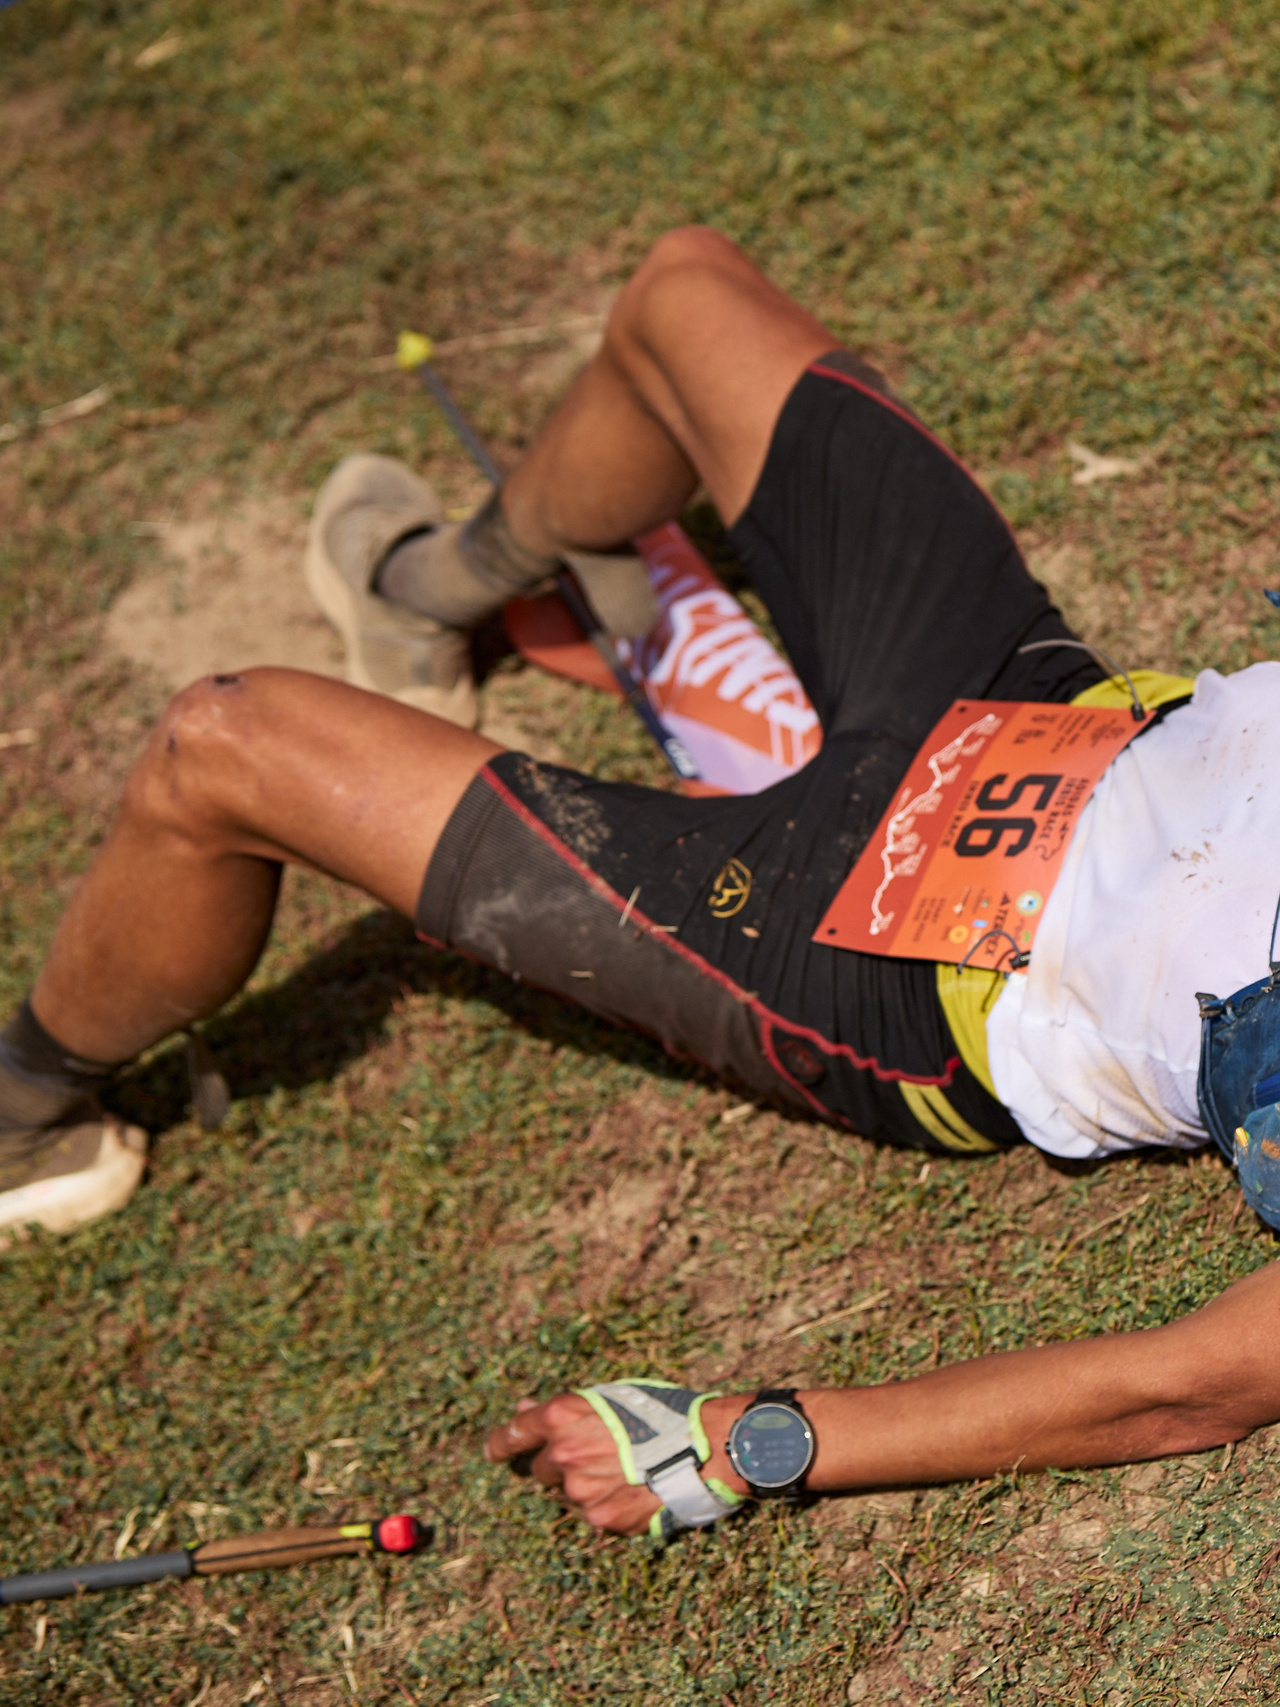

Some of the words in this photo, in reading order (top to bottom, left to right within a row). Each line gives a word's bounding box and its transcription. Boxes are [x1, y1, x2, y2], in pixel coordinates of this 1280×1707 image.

[954, 774, 1064, 857] 56
[1062, 778, 1090, 816] ADIDAS
[1040, 810, 1059, 839] RACE
